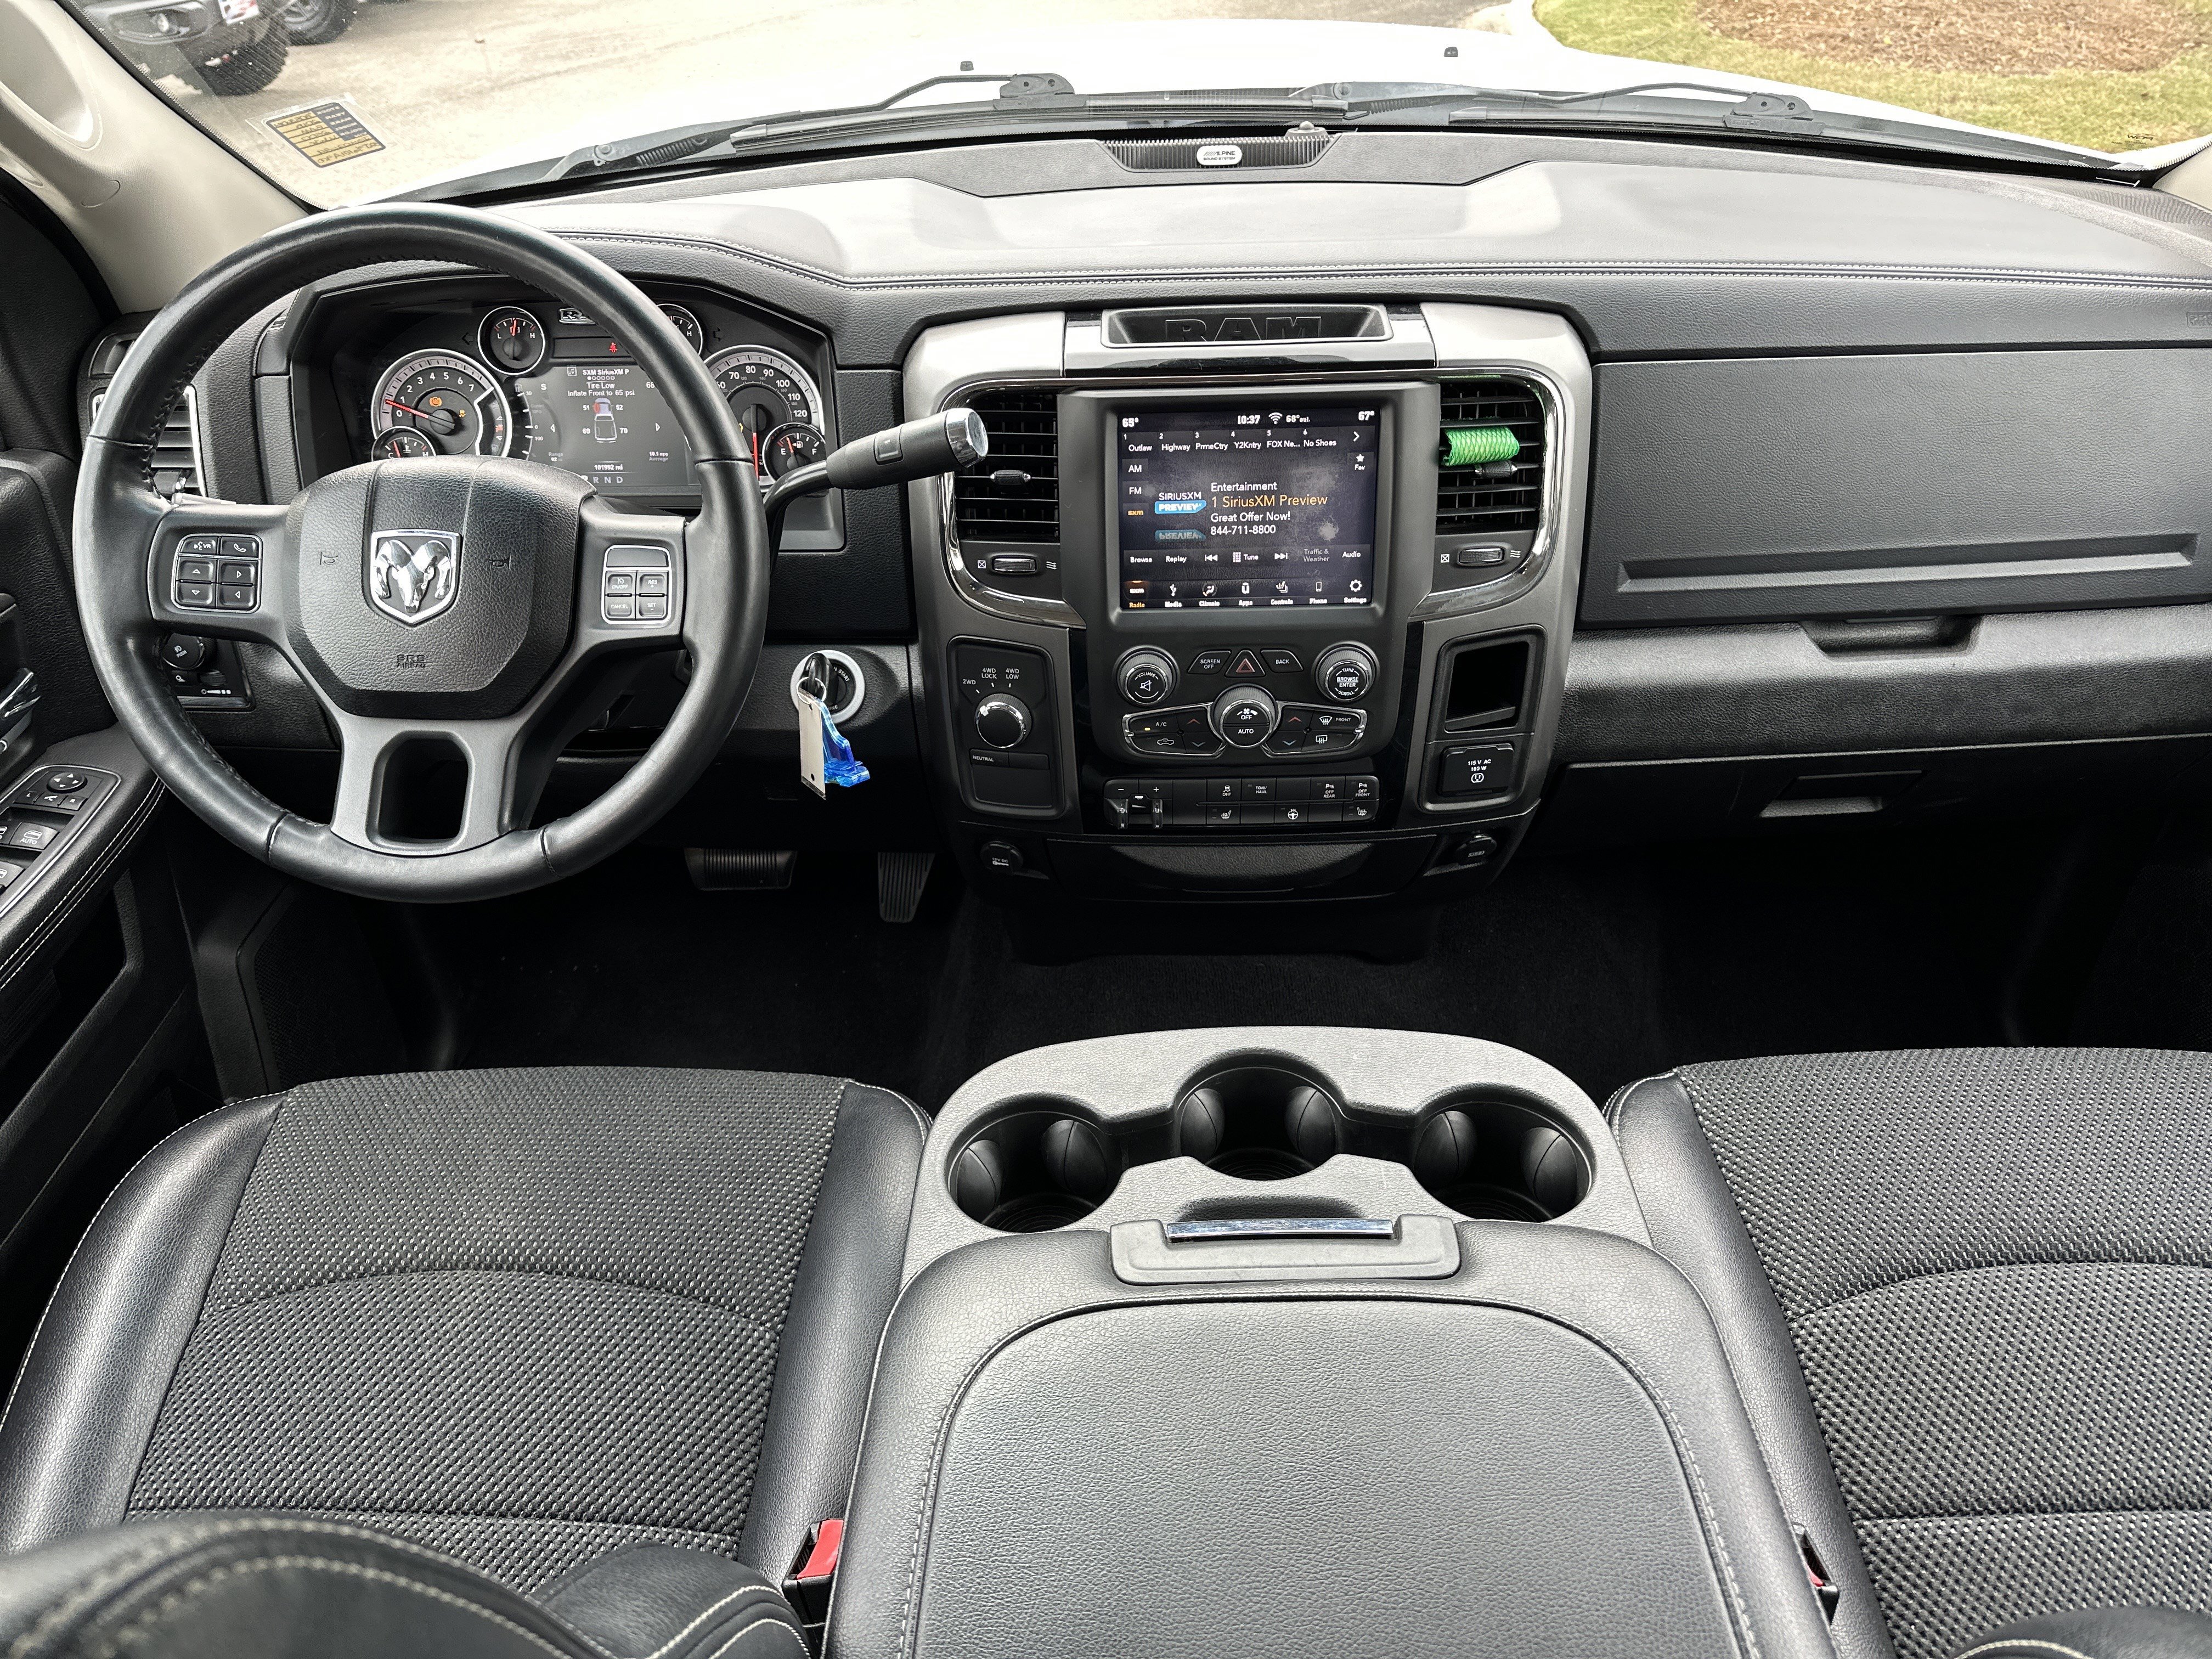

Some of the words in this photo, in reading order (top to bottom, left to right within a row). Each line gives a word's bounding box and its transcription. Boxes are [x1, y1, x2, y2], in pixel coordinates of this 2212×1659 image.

[1165, 317, 1322, 342] RAM
[746, 365, 756, 374] 80
[729, 371, 740, 380] 70
[1238, 415, 1260, 424] 10:37
[1161, 443, 1190, 452] Highway
[1195, 442, 1228, 450] PrmeCtry
[1234, 442, 1261, 450] Y2Kntry
[1211, 482, 1278, 492] Entertainment
[1159, 492, 1201, 500] SIRIUSXM
[1211, 496, 1216, 507] 1
[1222, 495, 1275, 507] SiriusXM
[1280, 494, 1328, 506] Preview
[1210, 513, 1237, 522] Great
[1240, 512, 1263, 521] Offer
[1266, 511, 1290, 521] Now!
[1210, 525, 1276, 535] 844-711-8800
[838, 669, 850, 681] START
